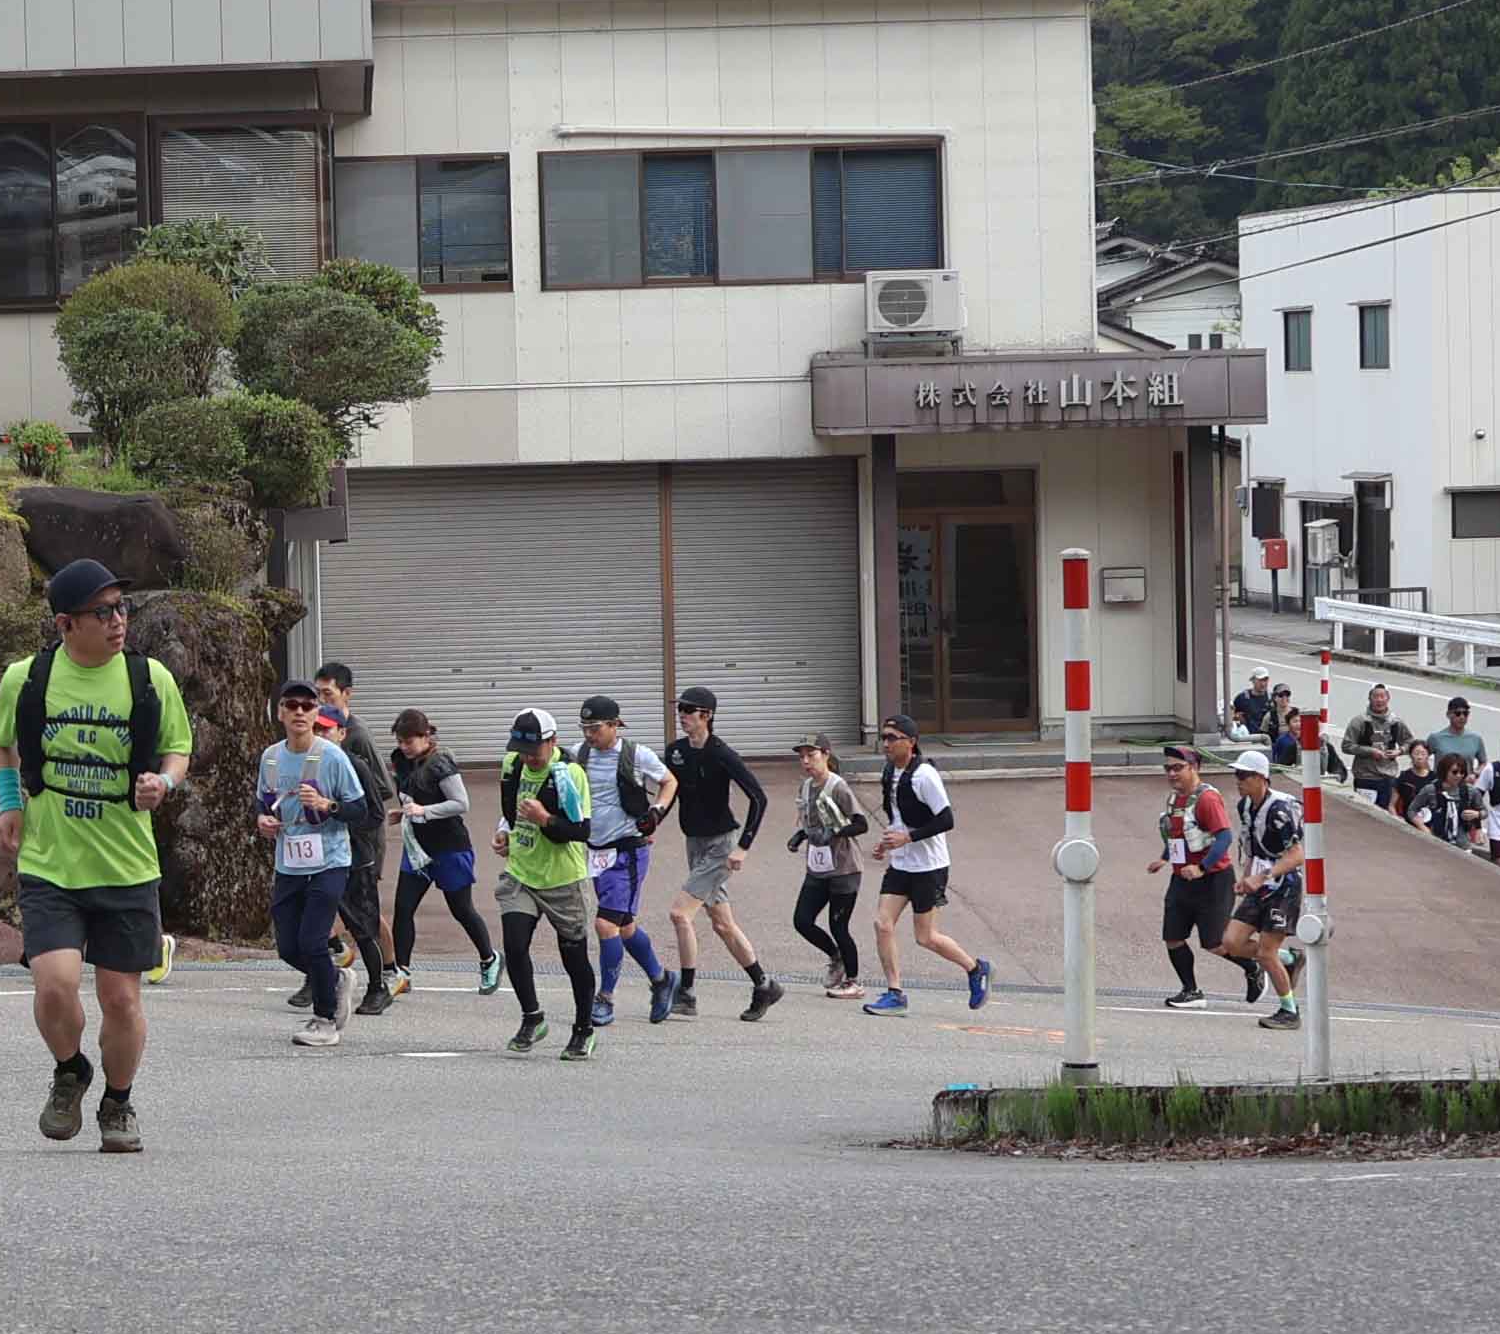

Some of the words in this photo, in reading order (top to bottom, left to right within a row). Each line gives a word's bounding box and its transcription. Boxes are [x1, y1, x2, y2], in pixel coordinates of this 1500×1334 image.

[915, 370, 1185, 408] 株式会社山本組
[64, 798, 104, 820] 5051
[286, 840, 314, 859] 113
